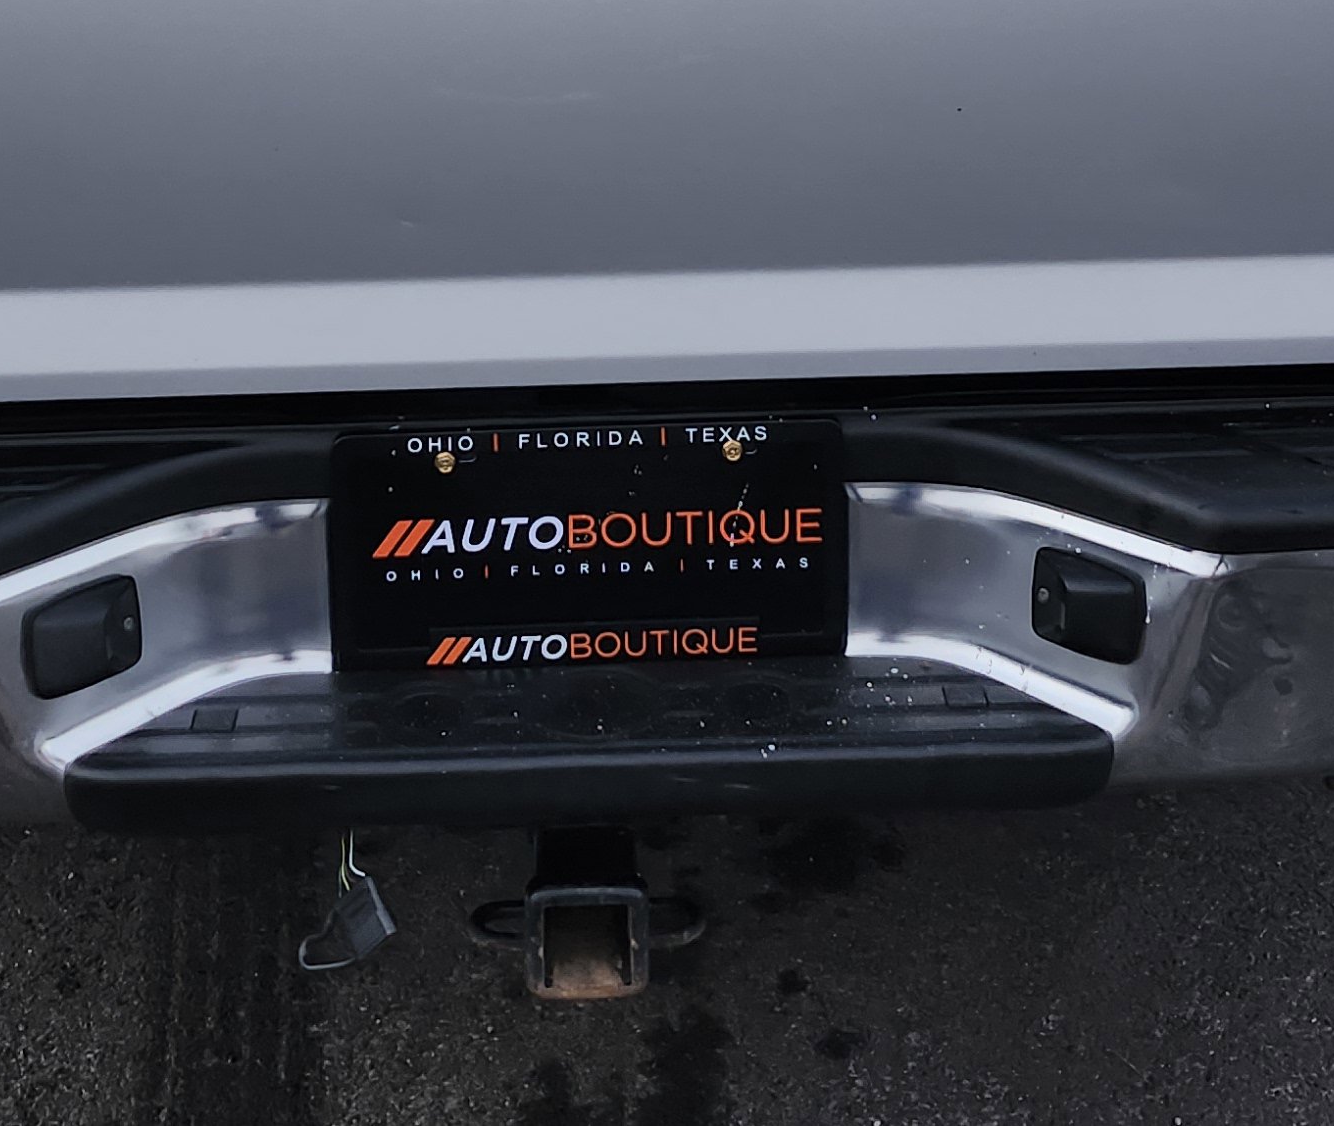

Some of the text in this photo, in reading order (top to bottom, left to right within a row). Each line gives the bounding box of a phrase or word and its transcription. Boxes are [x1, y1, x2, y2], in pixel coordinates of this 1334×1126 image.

[406, 425, 769, 454] OHIO FLORIDA TEXAS
[421, 507, 824, 555] AUTOBOUTIQUE
[385, 556, 810, 582] OHIO FLORIDA TEXAS
[462, 626, 759, 665] AUTOBOUTIQUE
